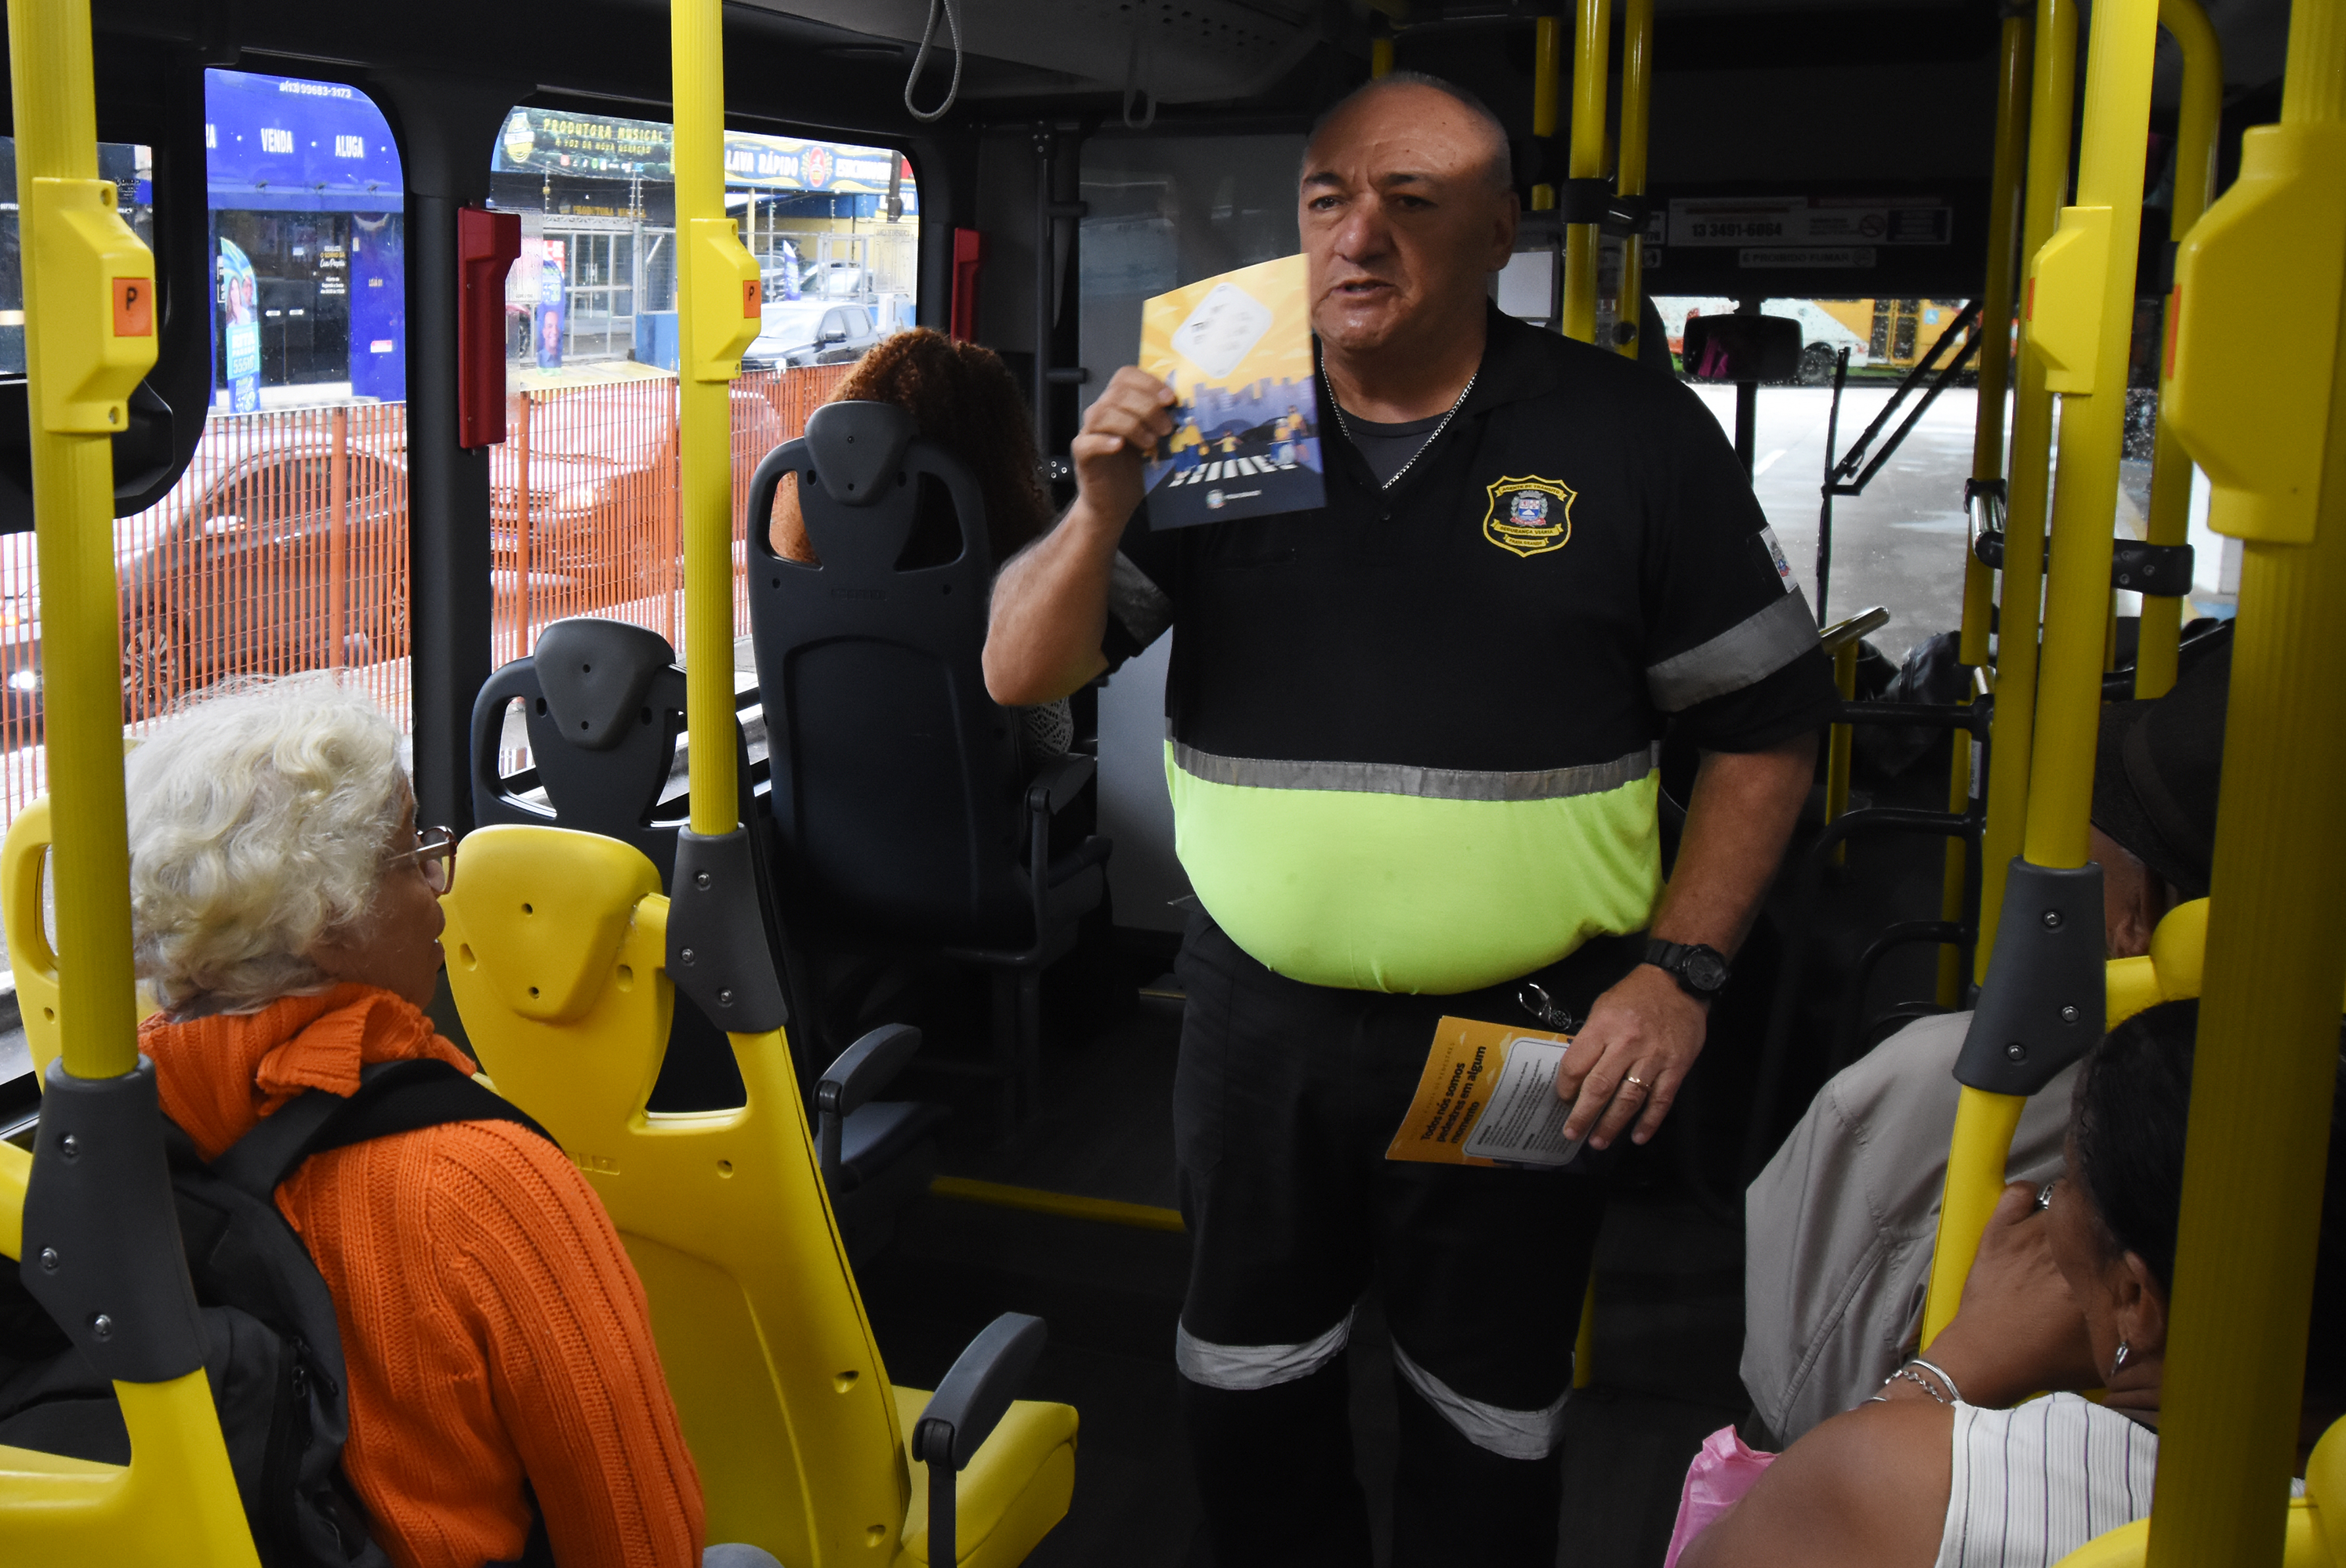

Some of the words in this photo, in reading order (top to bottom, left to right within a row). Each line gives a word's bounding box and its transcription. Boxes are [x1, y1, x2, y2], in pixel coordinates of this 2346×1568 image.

[261, 128, 293, 154] VENDA
[543, 118, 612, 140] PRODUTORA
[618, 127, 664, 142] MUSICAL
[335, 135, 364, 158] ALUGA
[724, 150, 754, 172] LAVA
[758, 150, 799, 177] RÁPIDO
[126, 287, 138, 310] P
[748, 285, 755, 301] P
[1499, 525, 1533, 535] SEGURANÇA
[1420, 1116, 1443, 1141] Todos
[1436, 1098, 1451, 1115] nós
[1446, 1062, 1466, 1098] somos
[1436, 1100, 1466, 1143] pedestres
[1460, 1083, 1473, 1099] em
[1467, 1045, 1487, 1081] algum
[1451, 1102, 1480, 1144] momento
